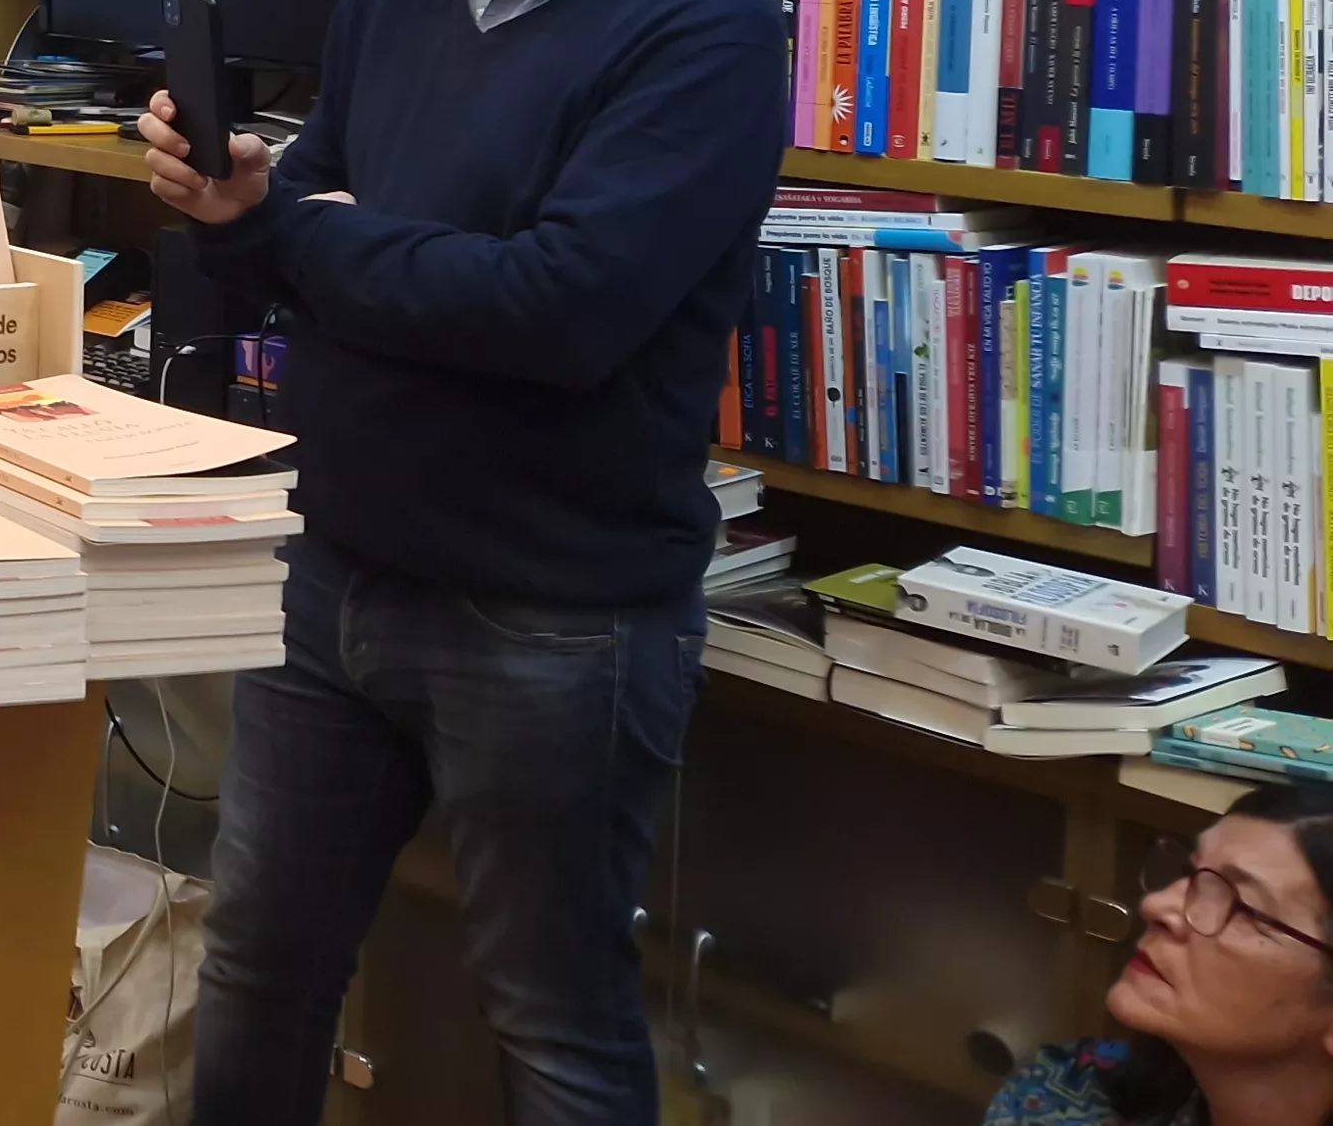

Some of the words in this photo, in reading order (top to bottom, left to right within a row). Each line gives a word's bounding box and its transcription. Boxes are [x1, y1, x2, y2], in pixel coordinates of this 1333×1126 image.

[837, 2, 854, 50] PALABRA
[899, 6, 907, 29] PEDRO
[837, 53, 851, 65] LA
[823, 257, 833, 293] BOSQUE
[825, 296, 834, 308] DE
[825, 310, 835, 335] BAÑO
[742, 334, 752, 362] SOFÍA
[743, 382, 754, 408] ÉTICA
